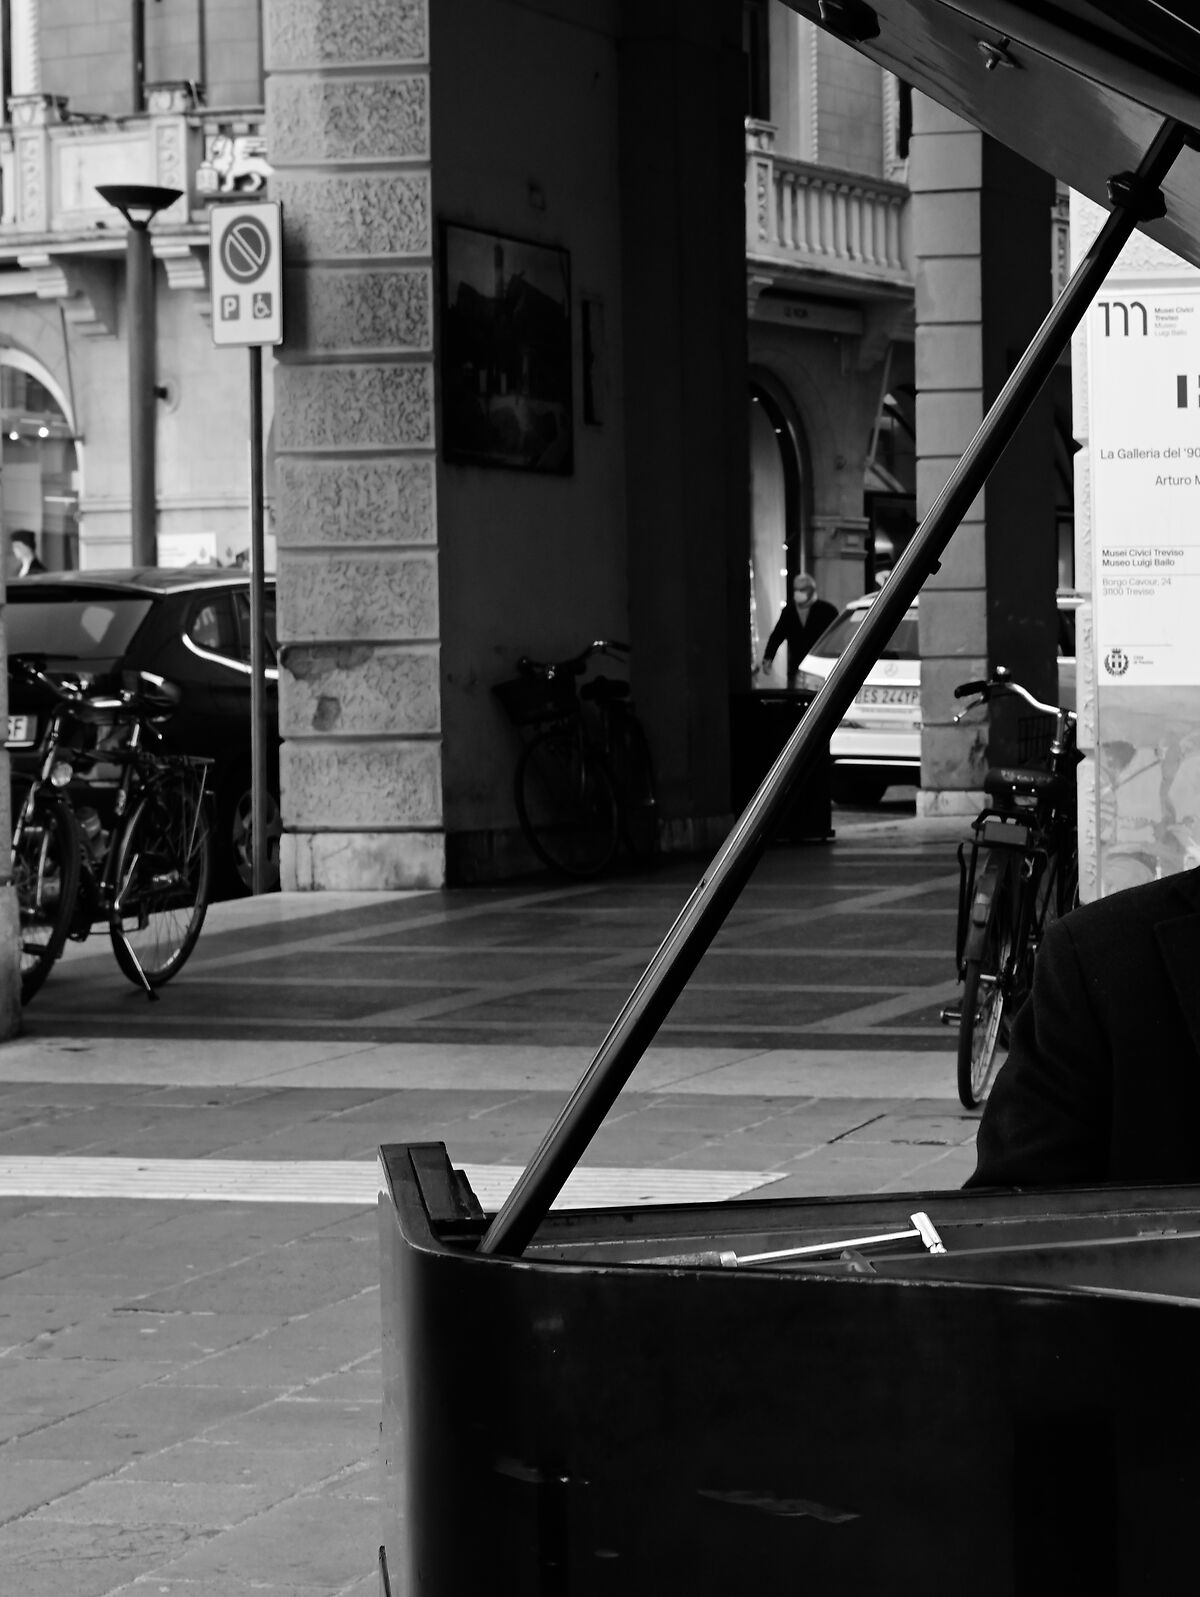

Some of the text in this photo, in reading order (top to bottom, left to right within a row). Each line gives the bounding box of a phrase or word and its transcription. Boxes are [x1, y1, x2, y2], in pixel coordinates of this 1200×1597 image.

[224, 297, 237, 318] P
[1101, 449, 1114, 459] La
[1117, 448, 1160, 459] Galleria
[1163, 448, 1180, 458] del
[1156, 475, 1191, 485] Arturo
[1129, 549, 1151, 557] Civici
[1132, 559, 1152, 568] Luigi
[1154, 558, 1175, 566] Bailo
[1102, 578, 1128, 587] Borgo
[1129, 578, 1159, 586] Cavour,
[1103, 587, 1155, 596] 31100 Treviso
